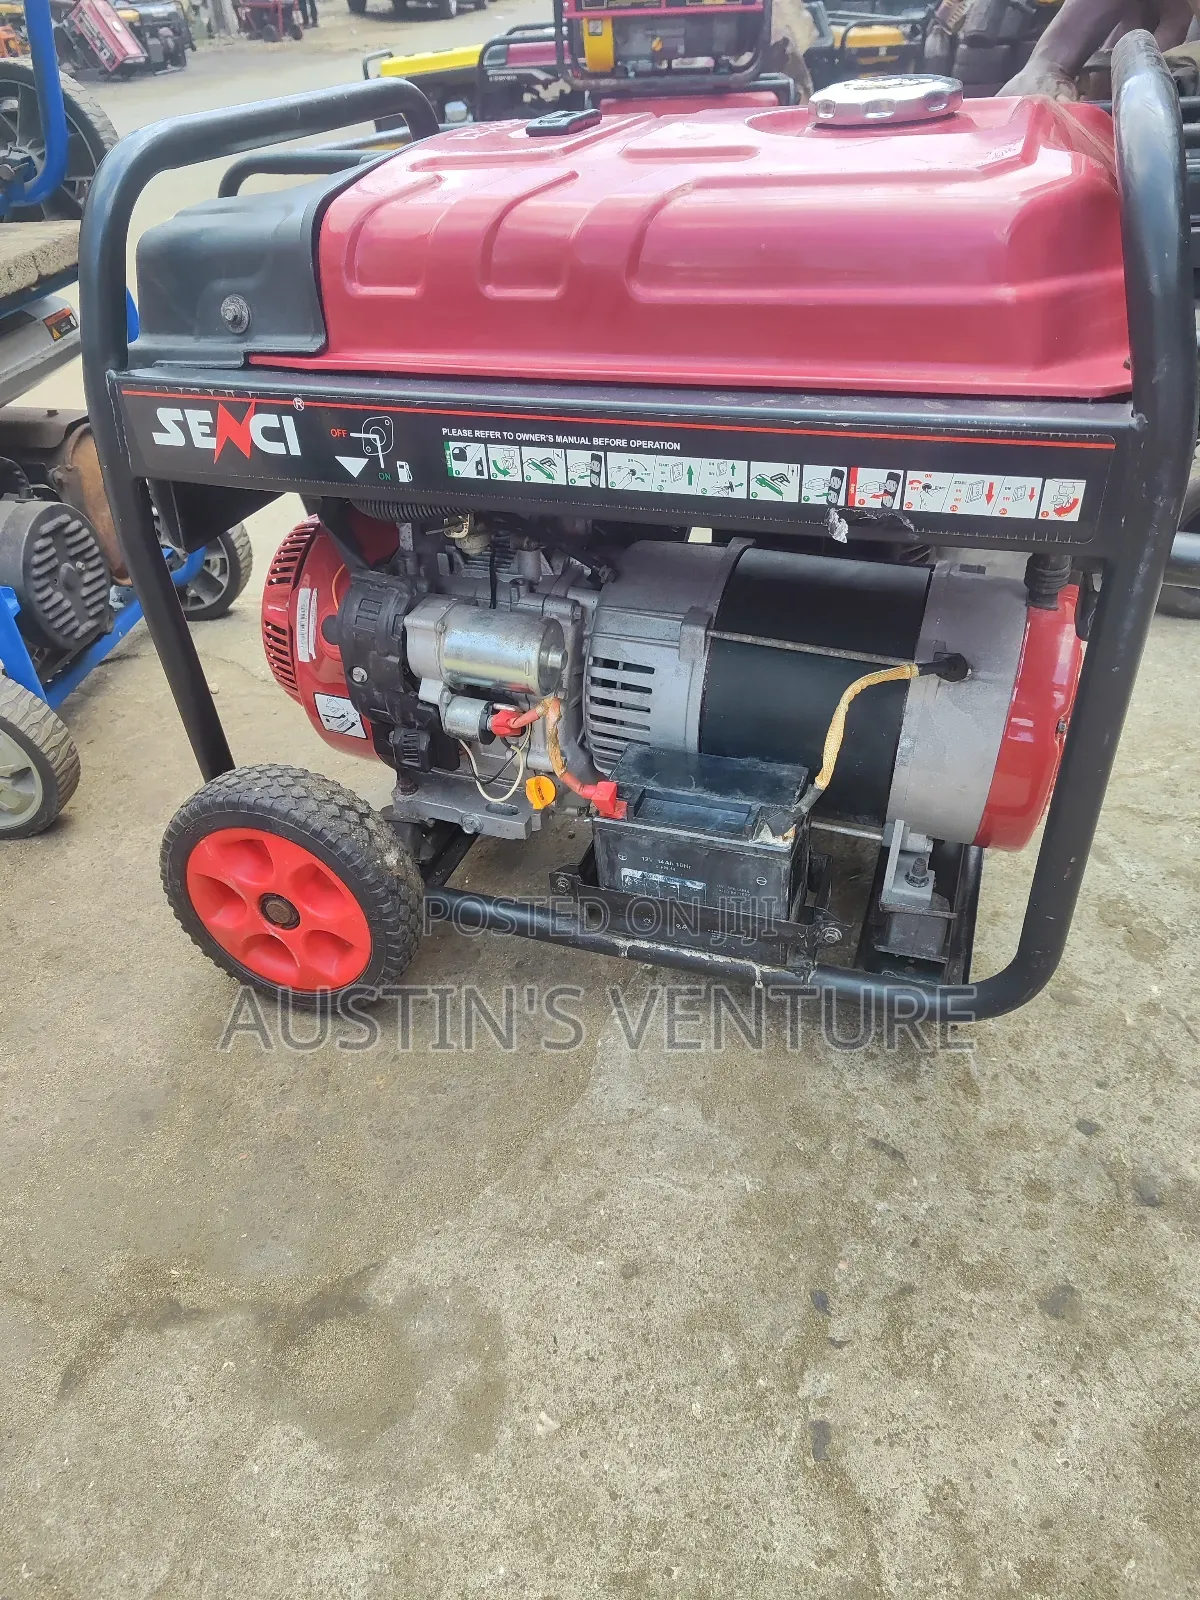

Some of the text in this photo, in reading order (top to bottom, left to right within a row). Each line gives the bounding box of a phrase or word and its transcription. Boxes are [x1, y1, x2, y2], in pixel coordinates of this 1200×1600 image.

[152, 398, 302, 464] SENCI
[330, 428, 347, 438] OFF
[442, 427, 681, 451] PLEASE REFER TO OWNER'S MANUAL BEFORE OPERATION
[378, 472, 391, 481] ON
